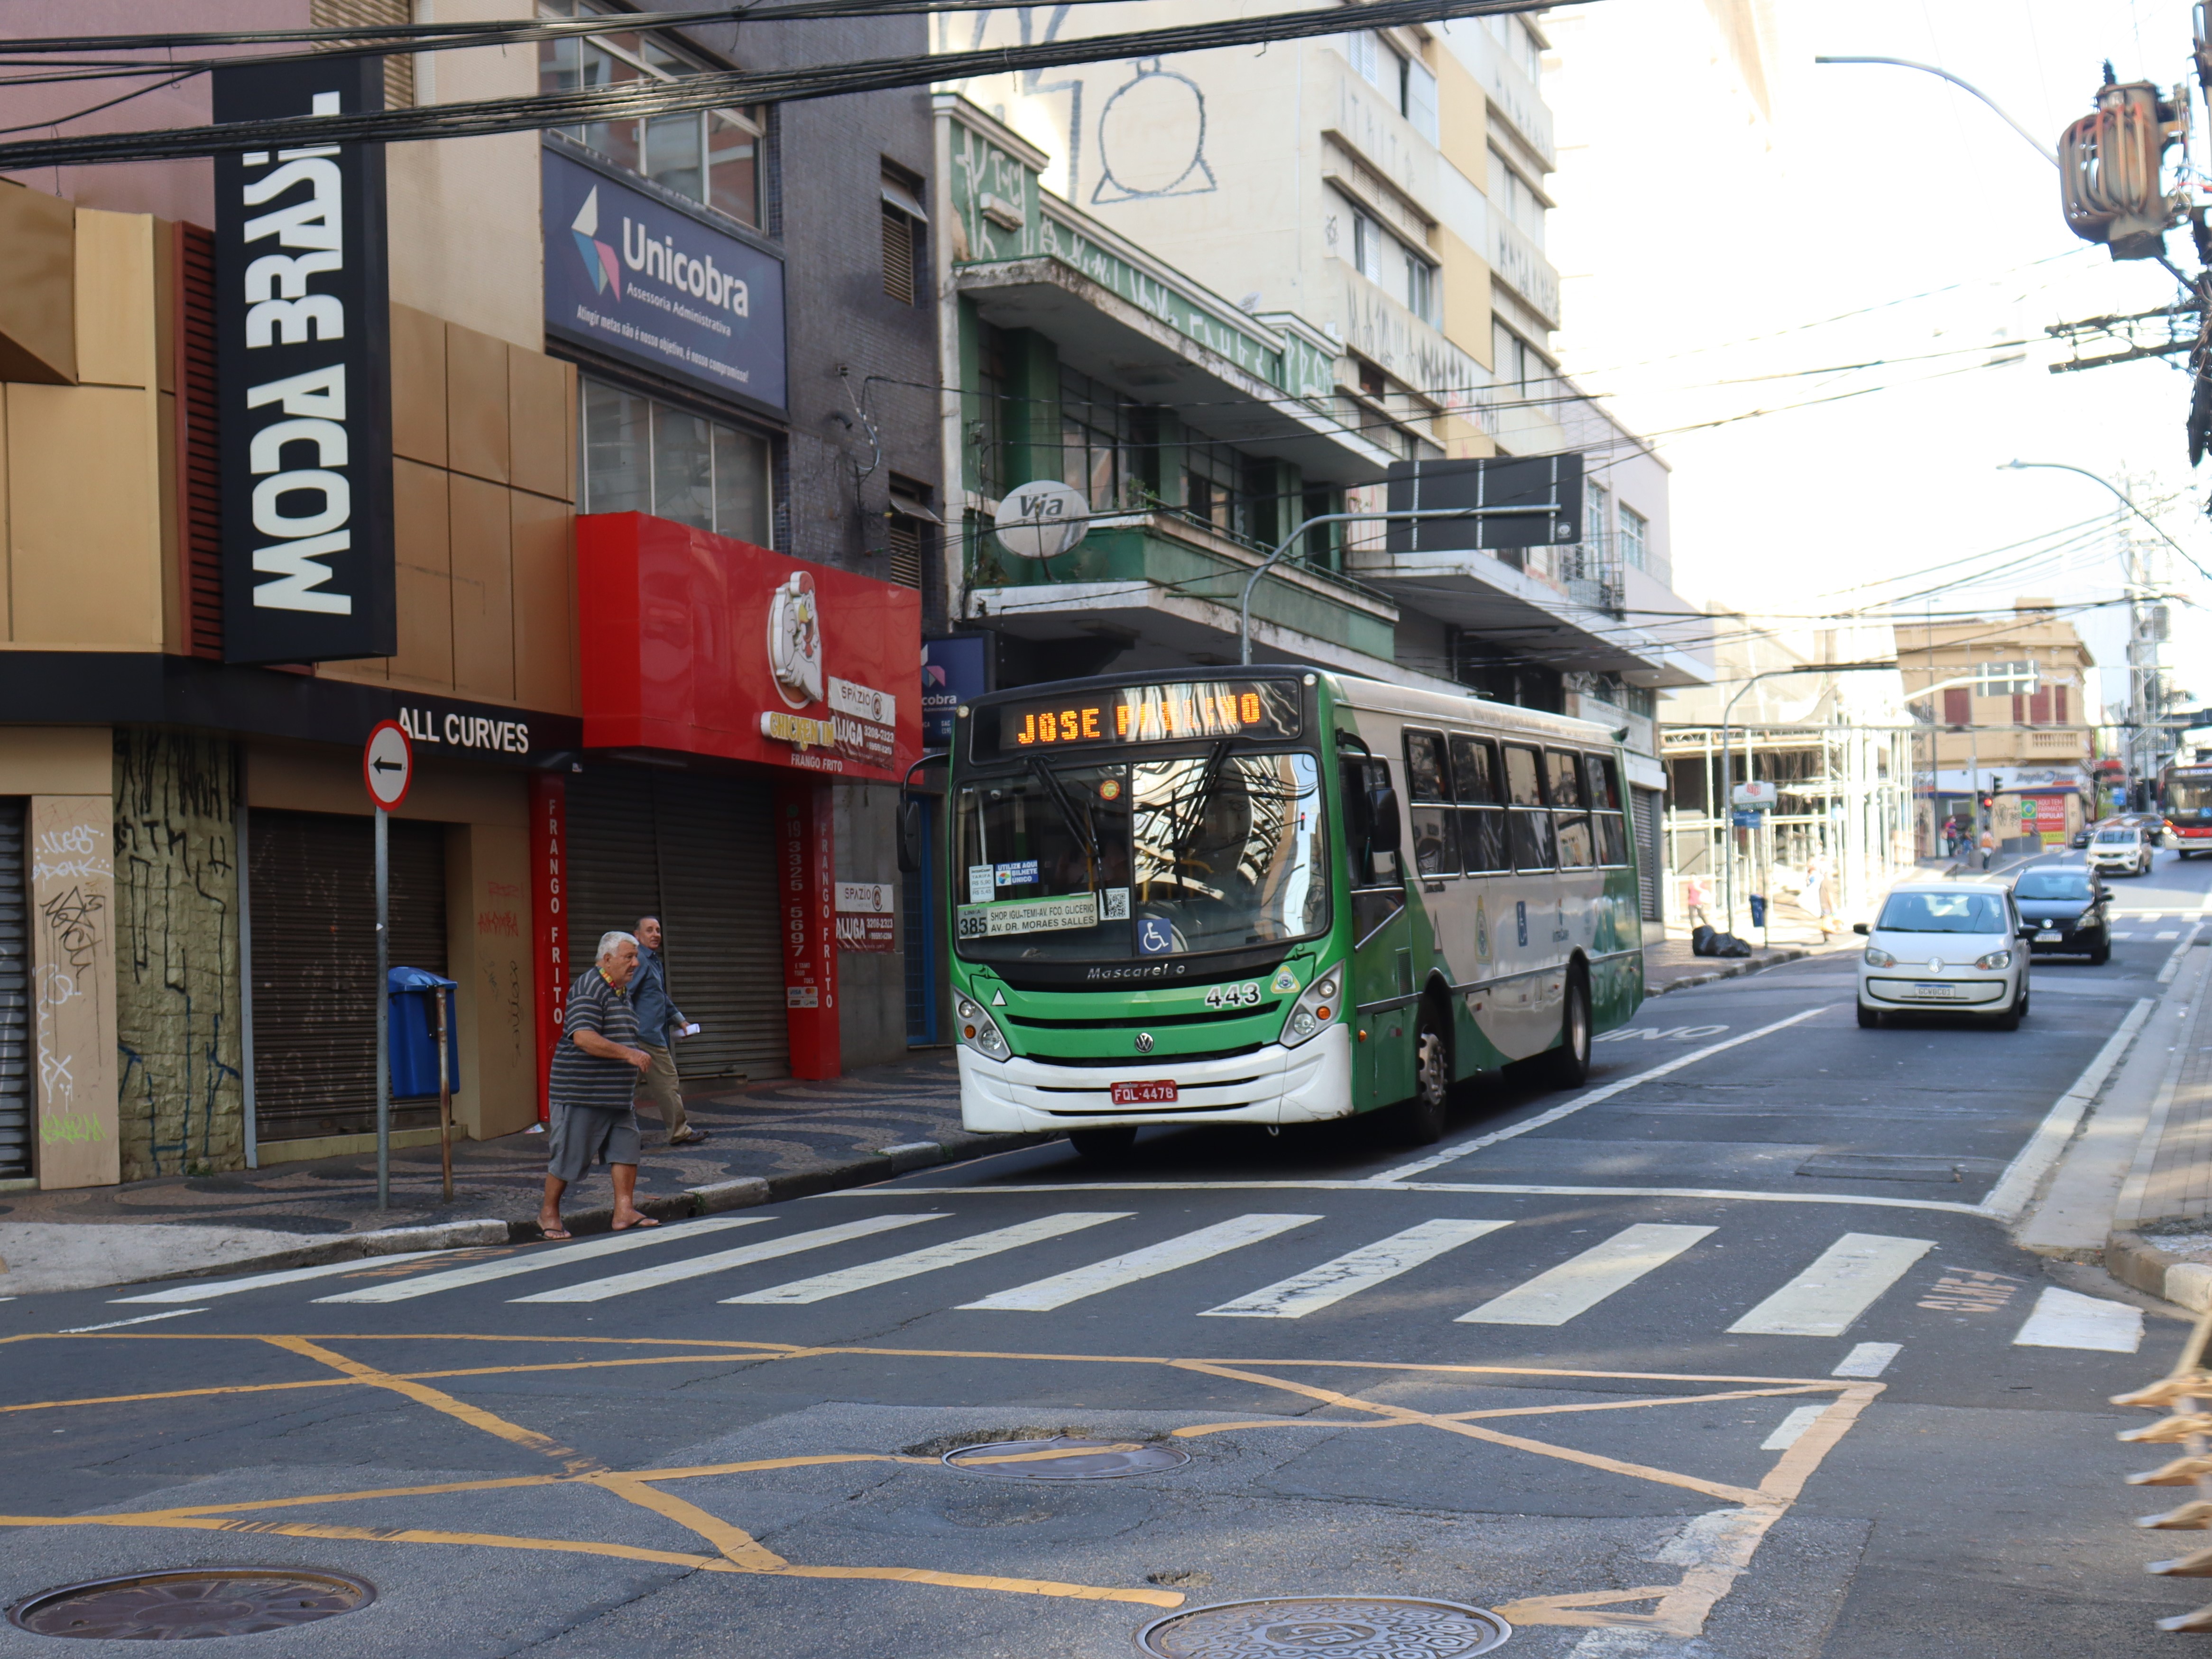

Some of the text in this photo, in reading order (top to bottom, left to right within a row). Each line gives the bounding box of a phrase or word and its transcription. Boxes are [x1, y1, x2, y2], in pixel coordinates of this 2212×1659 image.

[623, 216, 749, 318] Unicobra
[627, 282, 732, 337] Assessoria Administrativa
[577, 304, 599, 327] Atingir
[600, 315, 621, 333] metas
[621, 323, 634, 340] não
[635, 326, 639, 340] é
[640, 331, 658, 348] nosso
[691, 351, 708, 367] nosso
[247, 363, 351, 615] MODA
[1020, 493, 1063, 517] Via
[841, 686, 871, 706] SPAZIO
[922, 694, 957, 705] cobra
[399, 707, 529, 754] ALL CURVES
[768, 712, 834, 751] CHICKEN IN
[831, 716, 863, 747] ALUGA
[1018, 708, 1100, 744] JOSE
[791, 753, 843, 772] FRANGO FRITO
[997, 860, 1038, 871] UTILIZE AQUI
[1012, 876, 1032, 884] ÚNICO
[845, 888, 871, 900] SPAZIO
[549, 799, 563, 1025] FRANGO FRITO
[821, 822, 833, 1009] FRANGO FRITO
[991, 911, 1007, 921] SHOP.
[1050, 906, 1064, 916] FCO.
[1065, 902, 1094, 914] GLICÉRIO
[836, 918, 866, 940] ALUGA
[960, 917, 987, 936] 385
[991, 916, 1095, 932] AV. DR. MORAES SALLES
[1087, 963, 1185, 980] Mascarelo
[1205, 982, 1261, 1009] 443
